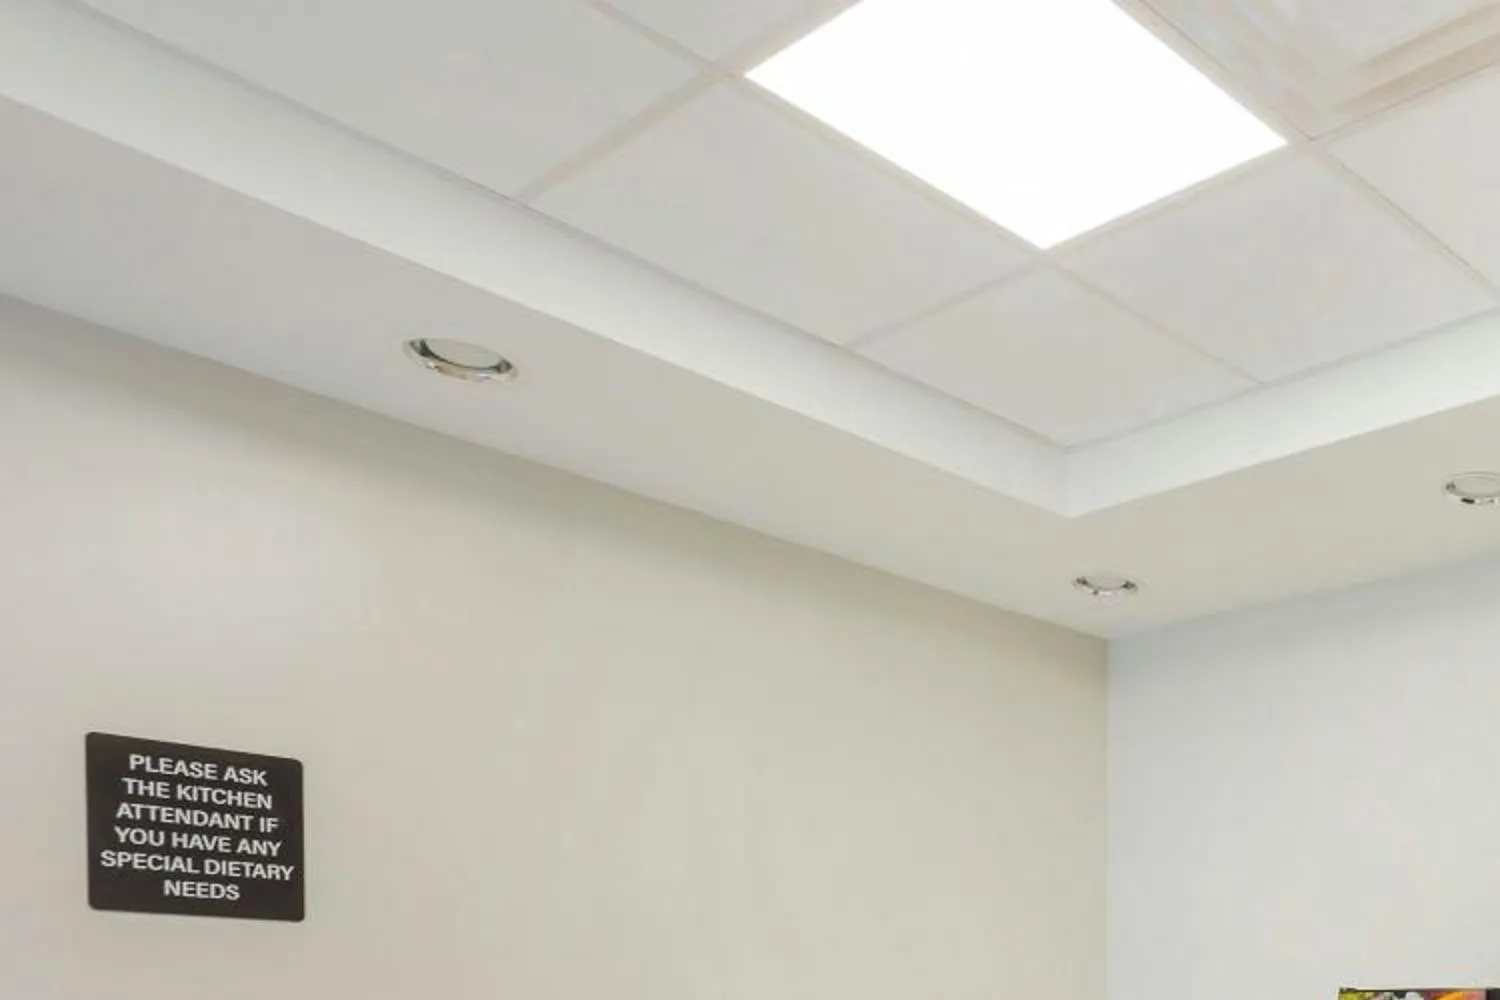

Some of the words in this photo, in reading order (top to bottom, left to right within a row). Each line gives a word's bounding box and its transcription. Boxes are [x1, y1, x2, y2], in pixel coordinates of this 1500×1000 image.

[129, 753, 218, 780] PLEASE
[223, 766, 268, 786] ASK
[121, 777, 170, 799] THE
[177, 784, 272, 810] KITCHEN
[116, 802, 254, 831] ATTENDANT
[259, 817, 279, 833] IF
[114, 826, 164, 847] YOU
[171, 832, 231, 853] HAVE
[236, 838, 282, 857] ANY
[100, 850, 200, 874] SPECIAL
[204, 859, 294, 881] DIETARY
[163, 880, 240, 901] NEEDS
